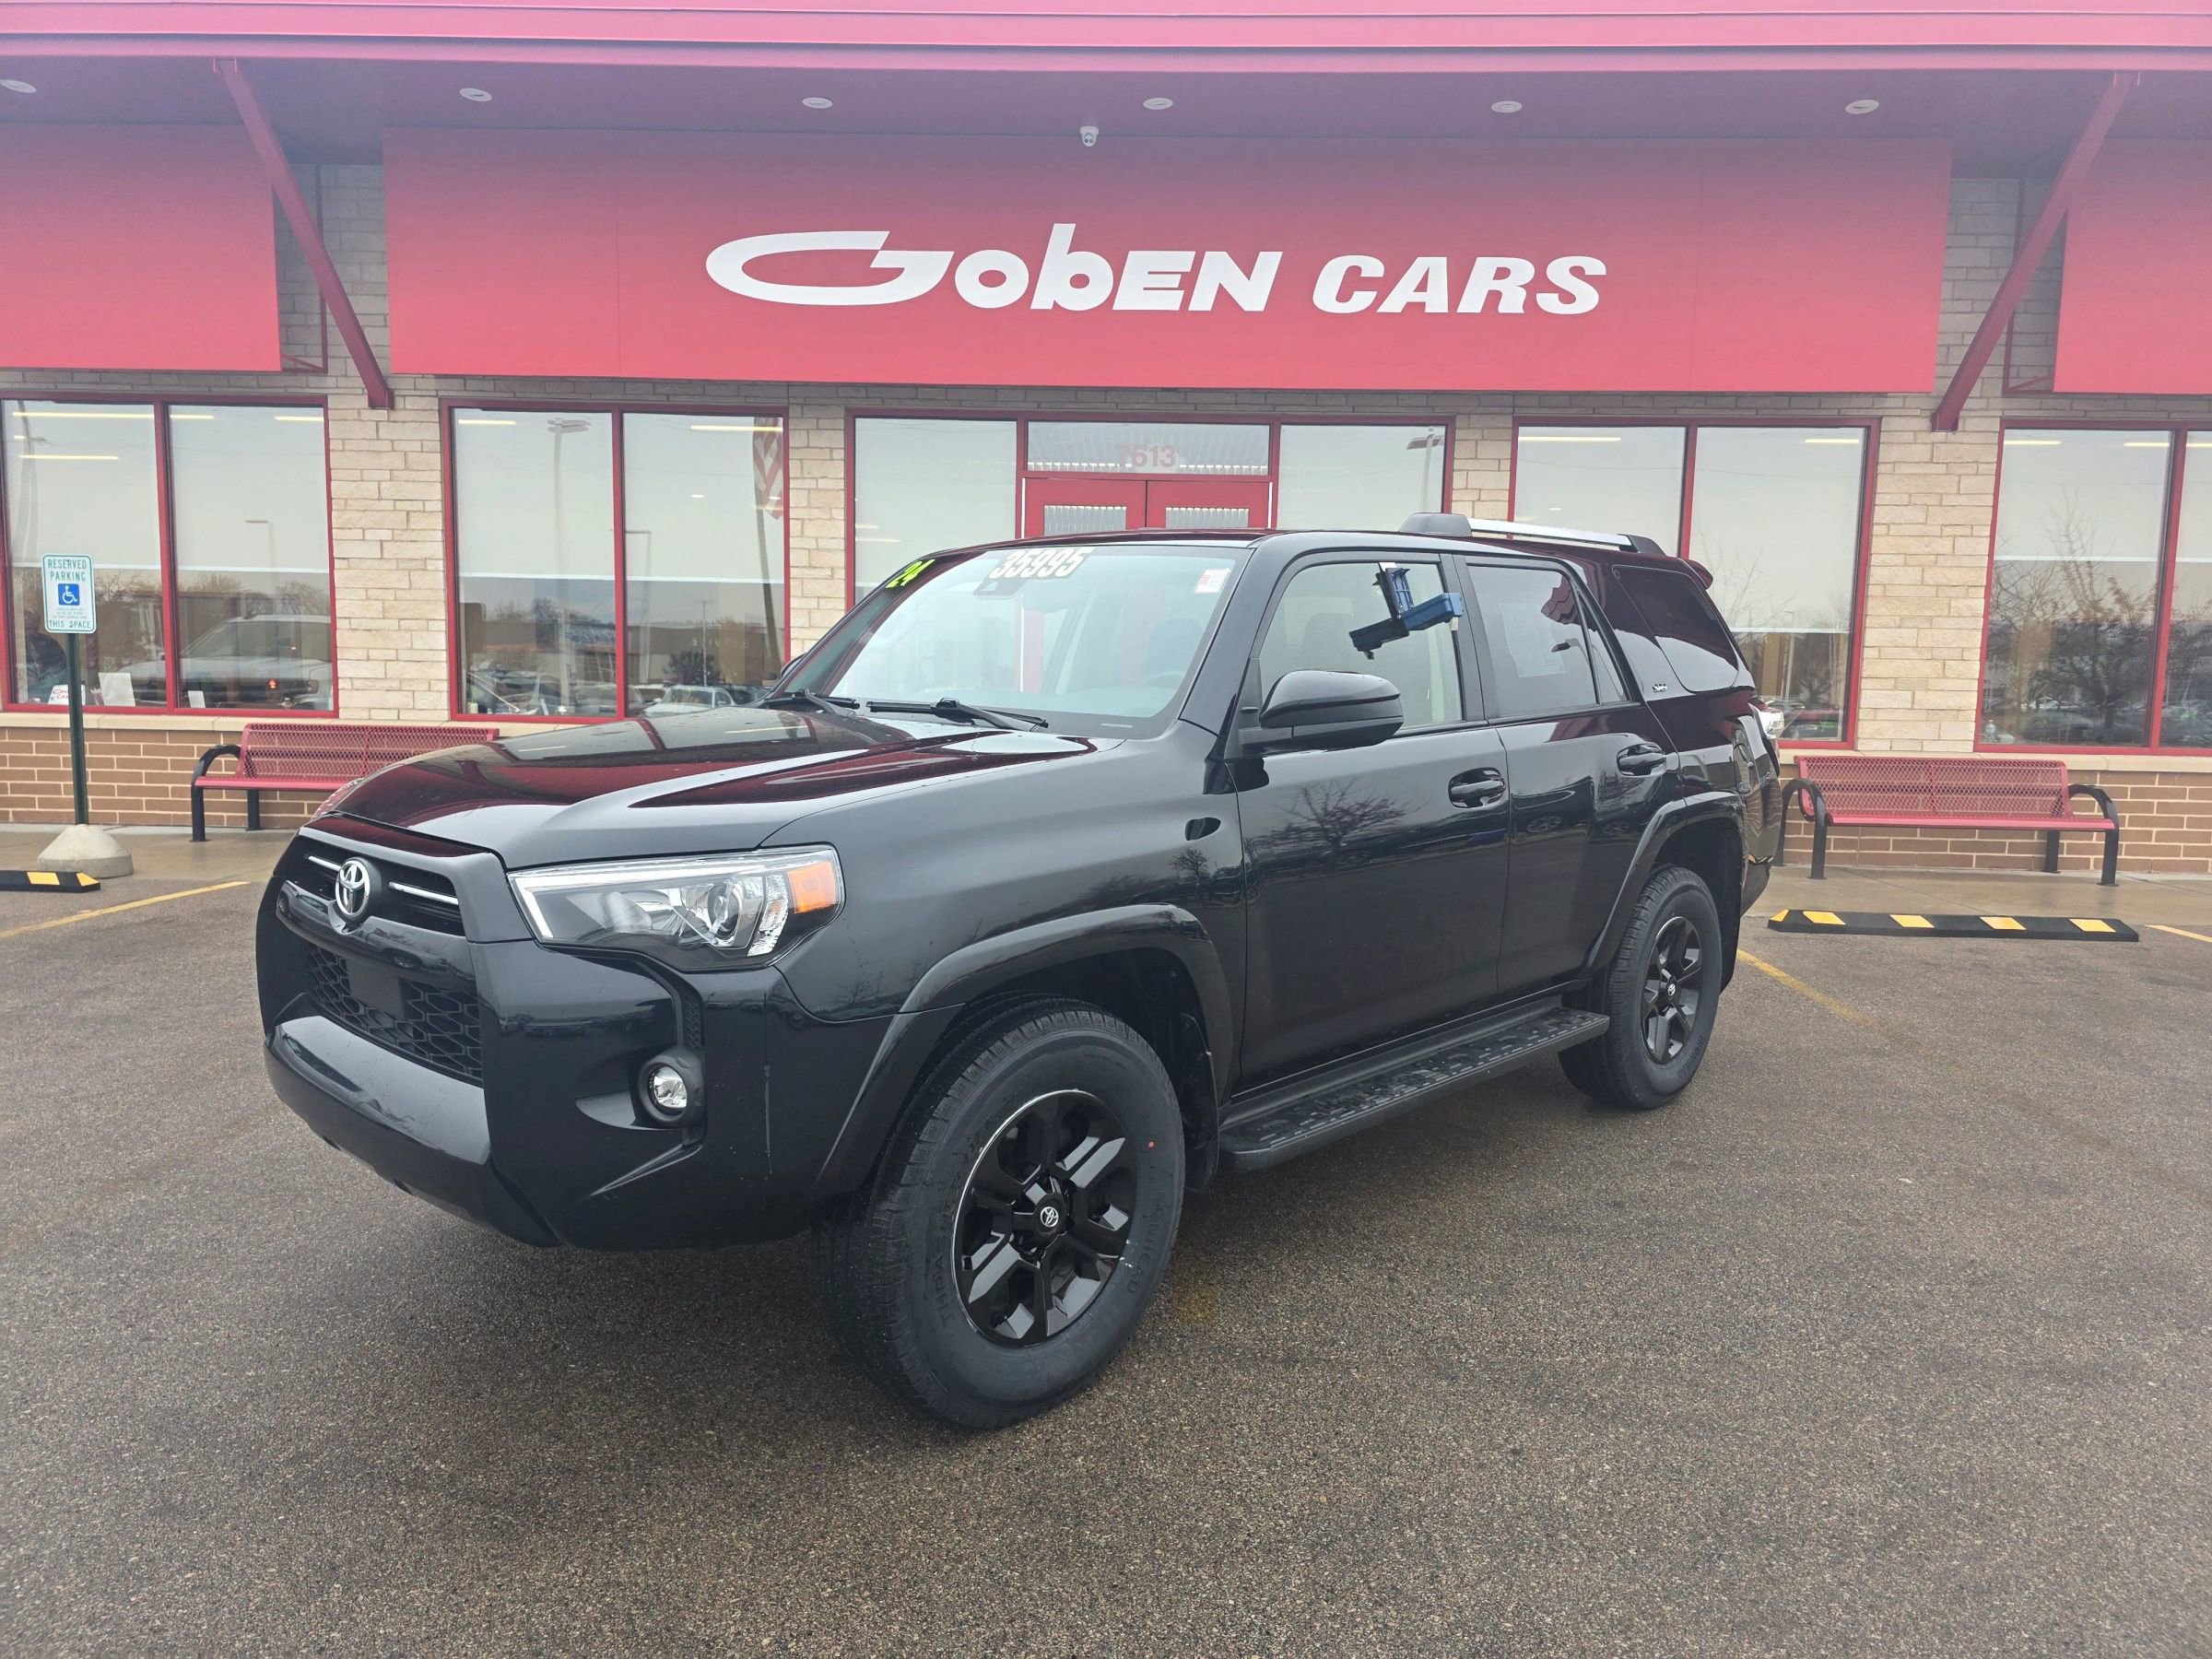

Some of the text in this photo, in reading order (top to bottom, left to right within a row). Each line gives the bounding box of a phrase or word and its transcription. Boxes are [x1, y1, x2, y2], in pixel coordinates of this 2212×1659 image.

[1312, 253, 1606, 315] CARS
[1118, 444, 1176, 468] 7613
[48, 559, 87, 570] RESERVED
[988, 547, 1095, 579] 35995
[51, 571, 86, 582] PARKING
[49, 619, 91, 629] THIS SPACE
